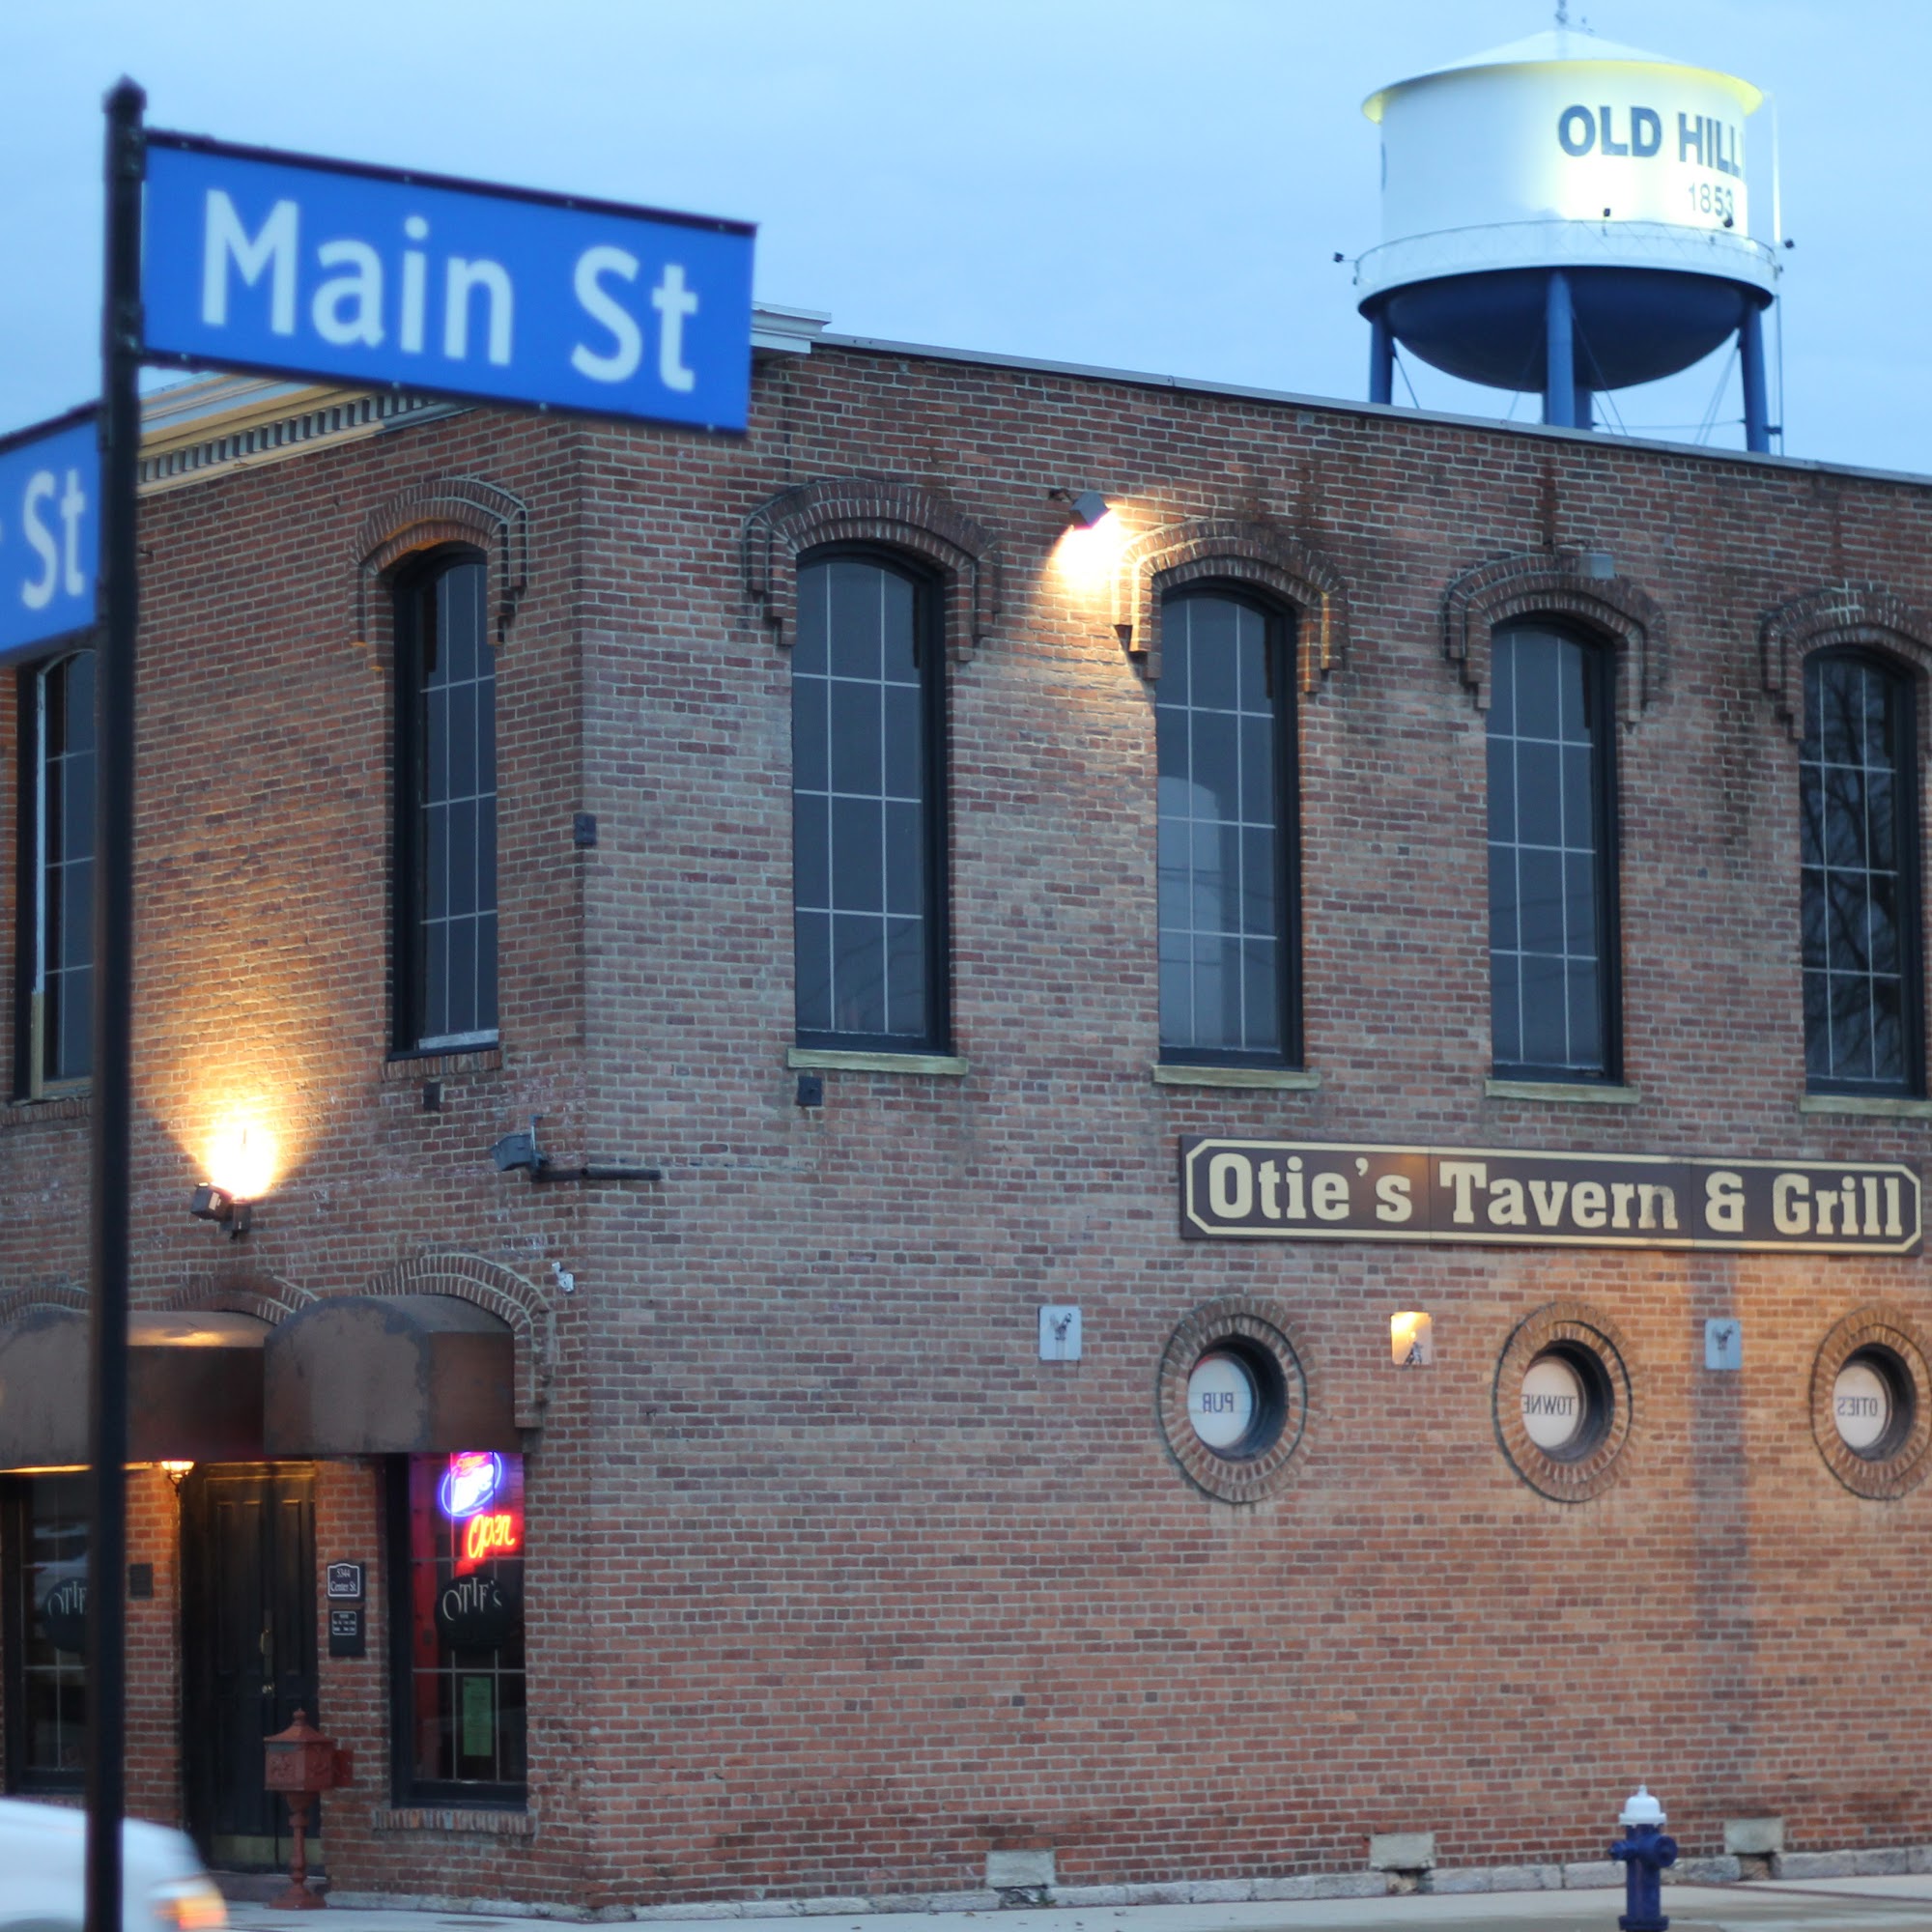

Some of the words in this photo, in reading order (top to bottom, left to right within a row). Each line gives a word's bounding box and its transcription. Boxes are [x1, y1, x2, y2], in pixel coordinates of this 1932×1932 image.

[1557, 104, 1662, 157] OLD
[202, 188, 514, 366] Main
[570, 245, 698, 392] St
[22, 469, 86, 609] St
[1208, 1152, 1413, 1223] Otie's
[1439, 1161, 1678, 1230] Tavern
[1705, 1171, 1746, 1233] &
[1773, 1173, 1903, 1236] Grill
[468, 1514, 516, 1559] Open
